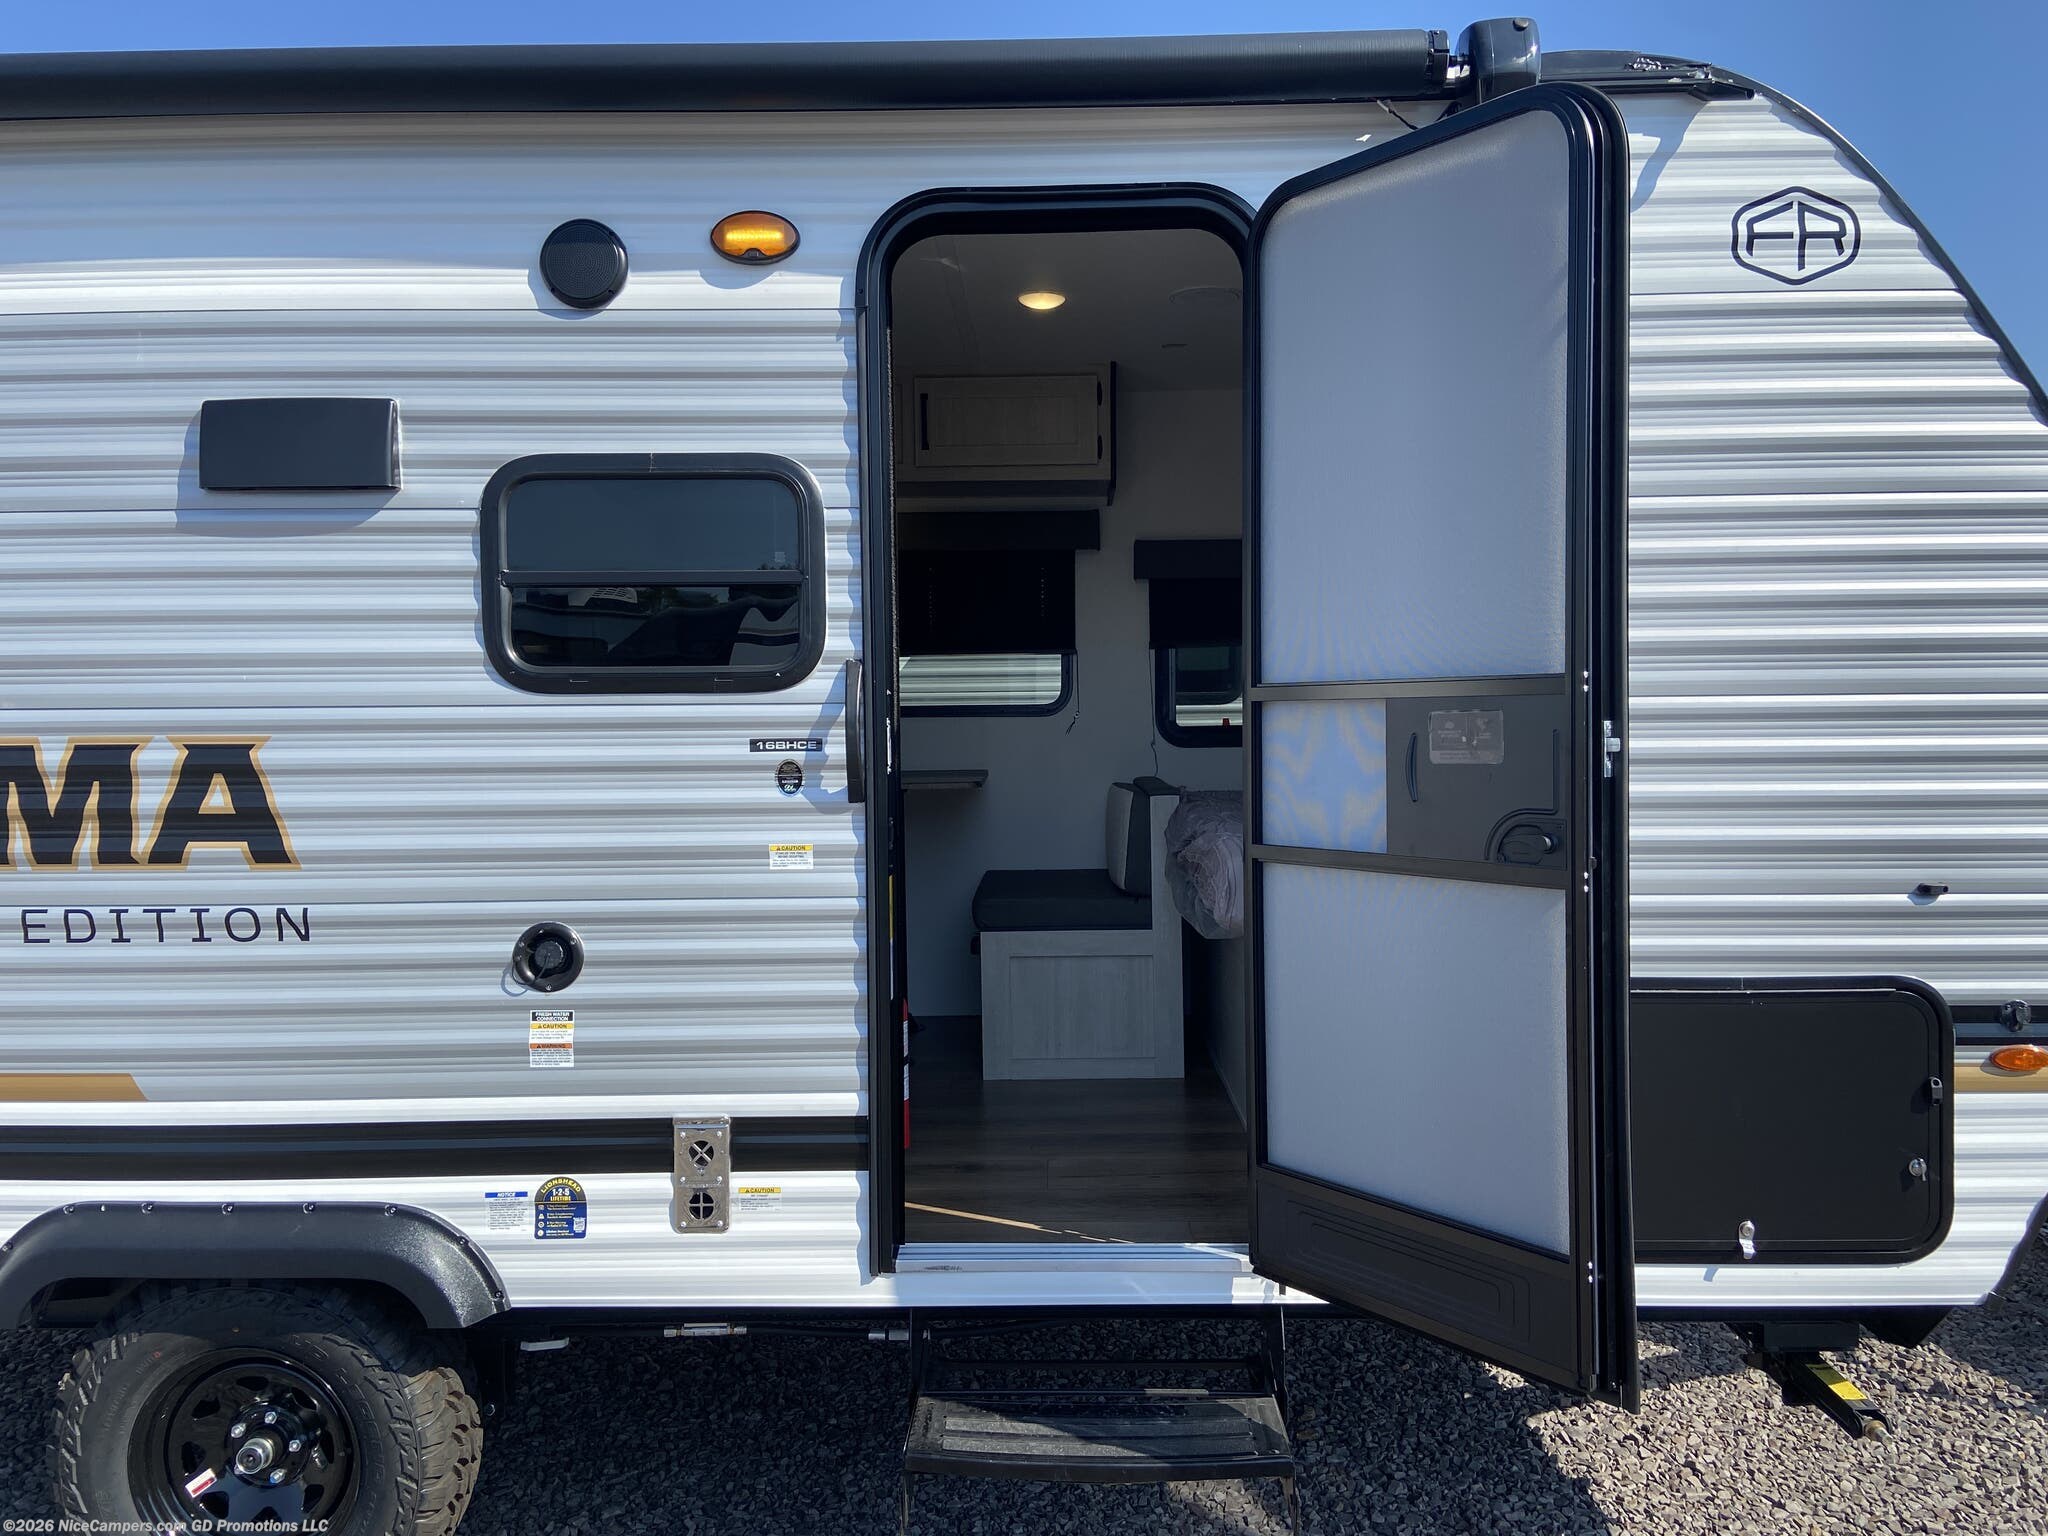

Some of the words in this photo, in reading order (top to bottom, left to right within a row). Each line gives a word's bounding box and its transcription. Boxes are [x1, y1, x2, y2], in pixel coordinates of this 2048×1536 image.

[756, 741, 817, 750] 16BHCE
[21, 907, 310, 943] EDITION
[540, 1178, 581, 1194] LIONSHEAD
